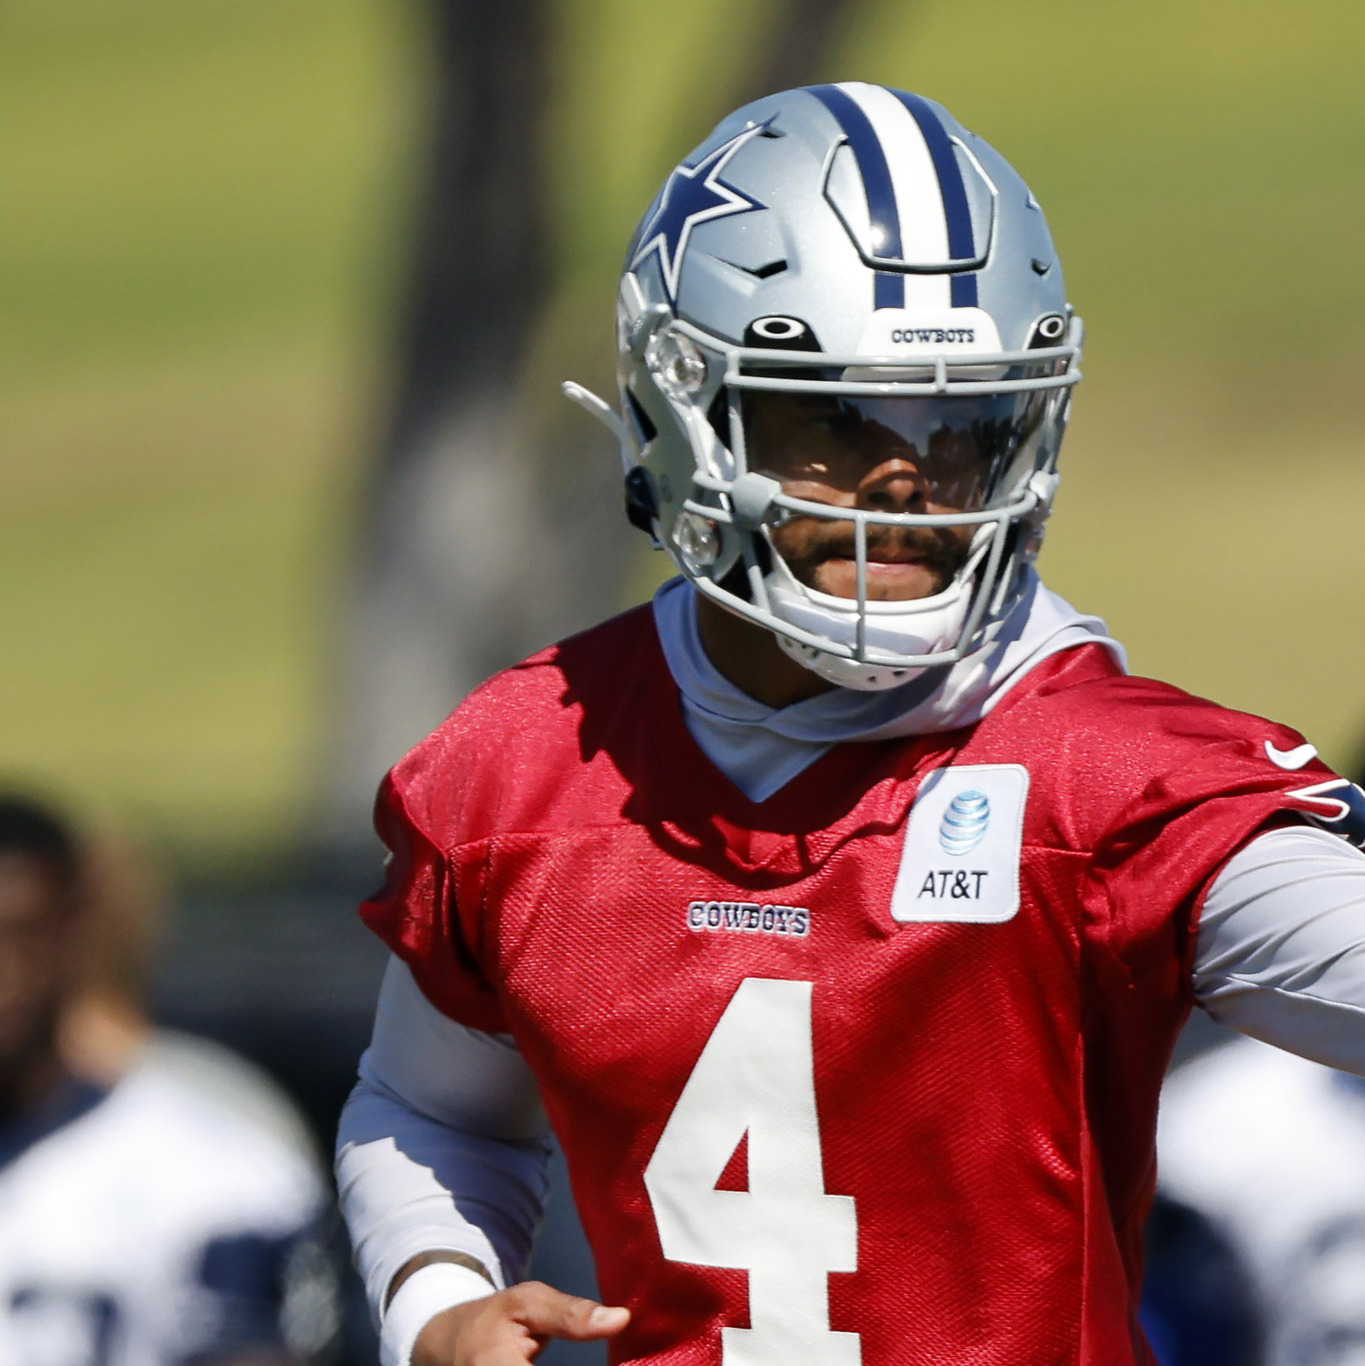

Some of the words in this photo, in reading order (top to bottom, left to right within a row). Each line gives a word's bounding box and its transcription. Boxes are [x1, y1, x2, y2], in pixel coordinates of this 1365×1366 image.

[891, 328, 975, 344] COWBOYS
[917, 869, 988, 899] AT&T
[687, 901, 811, 937] COWBOYS
